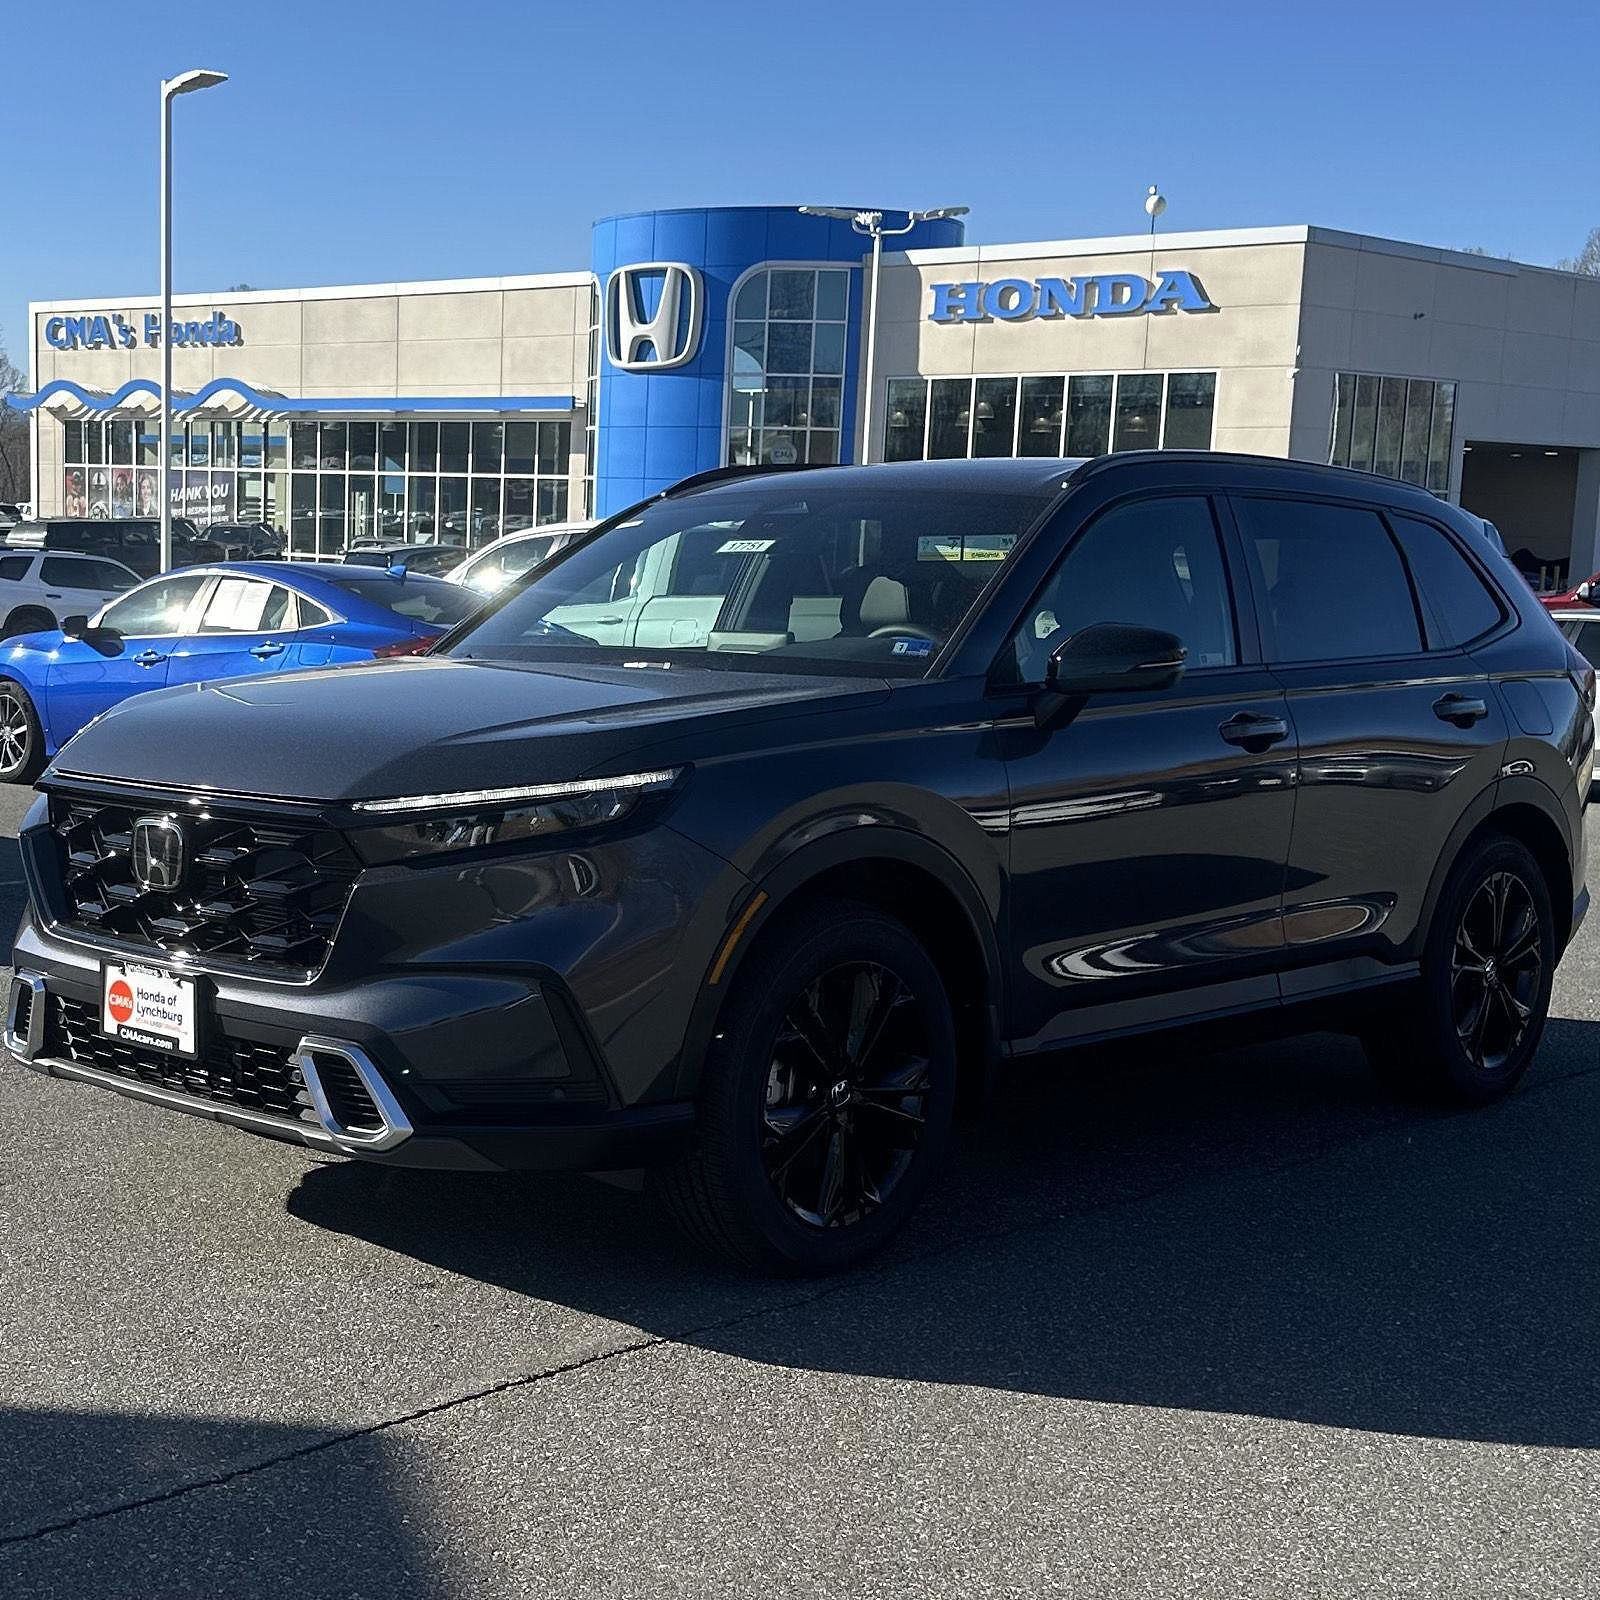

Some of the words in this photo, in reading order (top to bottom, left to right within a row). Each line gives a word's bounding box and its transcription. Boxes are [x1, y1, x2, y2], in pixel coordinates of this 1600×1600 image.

[928, 270, 1212, 322] HONDA
[46, 314, 134, 348] CMA's
[170, 486, 202, 502] HANK
[136, 986, 166, 1005] Honda
[167, 994, 178, 1006] of
[136, 1001, 183, 1026] Lynchburg
[120, 1028, 173, 1050] CMAcars.com
